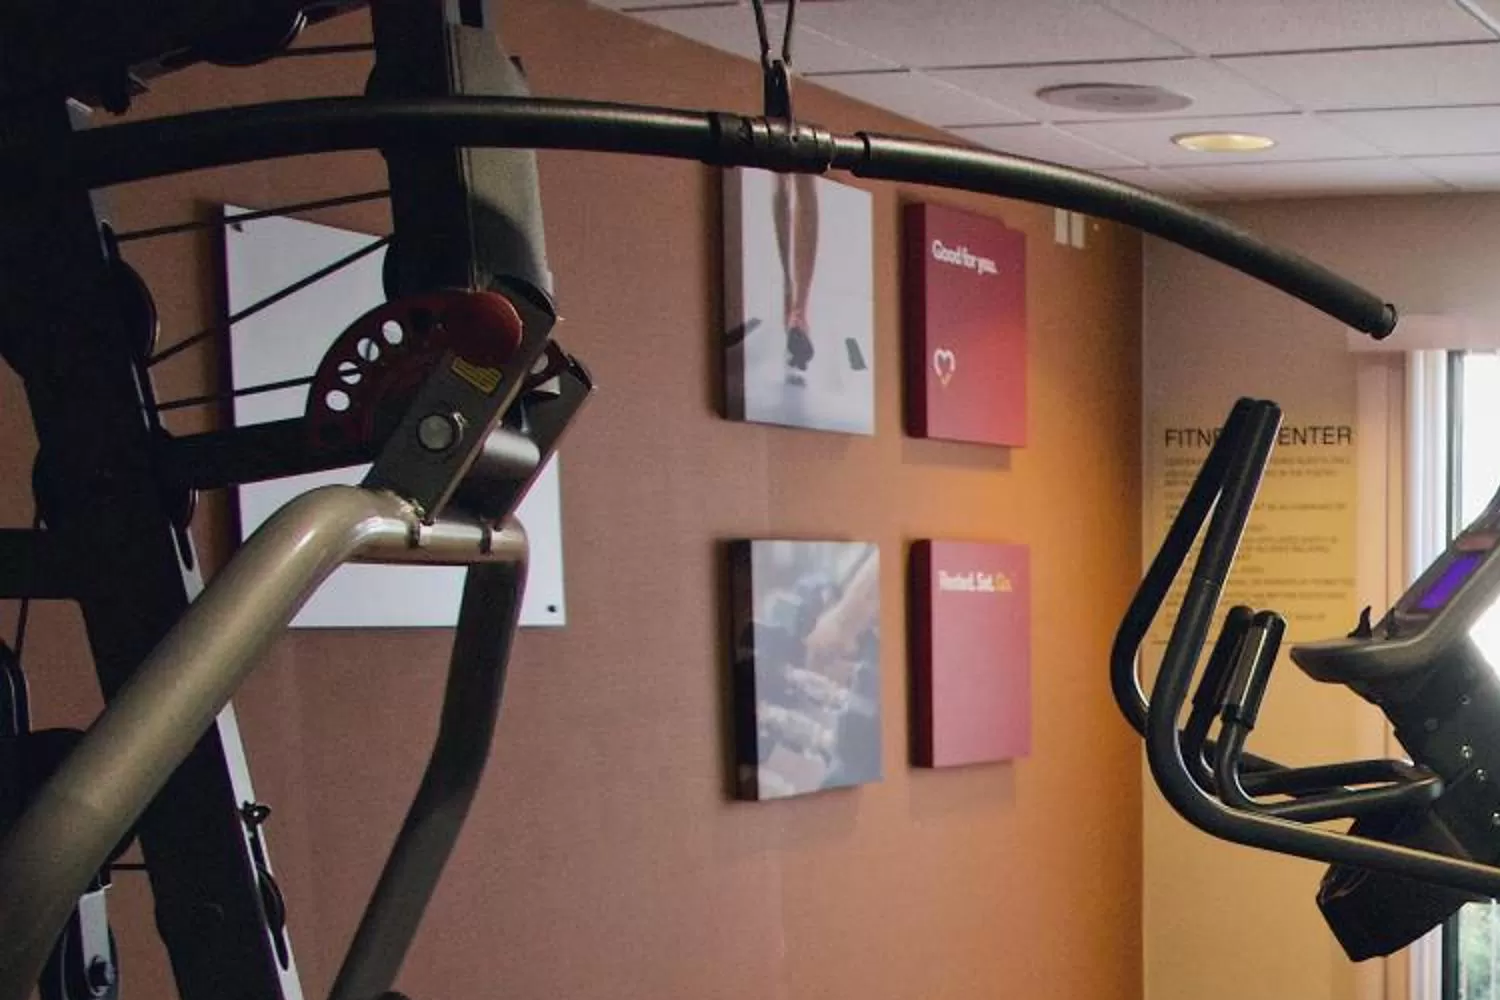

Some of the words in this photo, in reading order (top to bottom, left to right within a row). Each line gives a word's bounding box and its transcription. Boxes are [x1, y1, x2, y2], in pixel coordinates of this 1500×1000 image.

[932, 239, 962, 265] Good
[963, 246, 977, 269] for
[1278, 425, 1352, 446] ENTER
